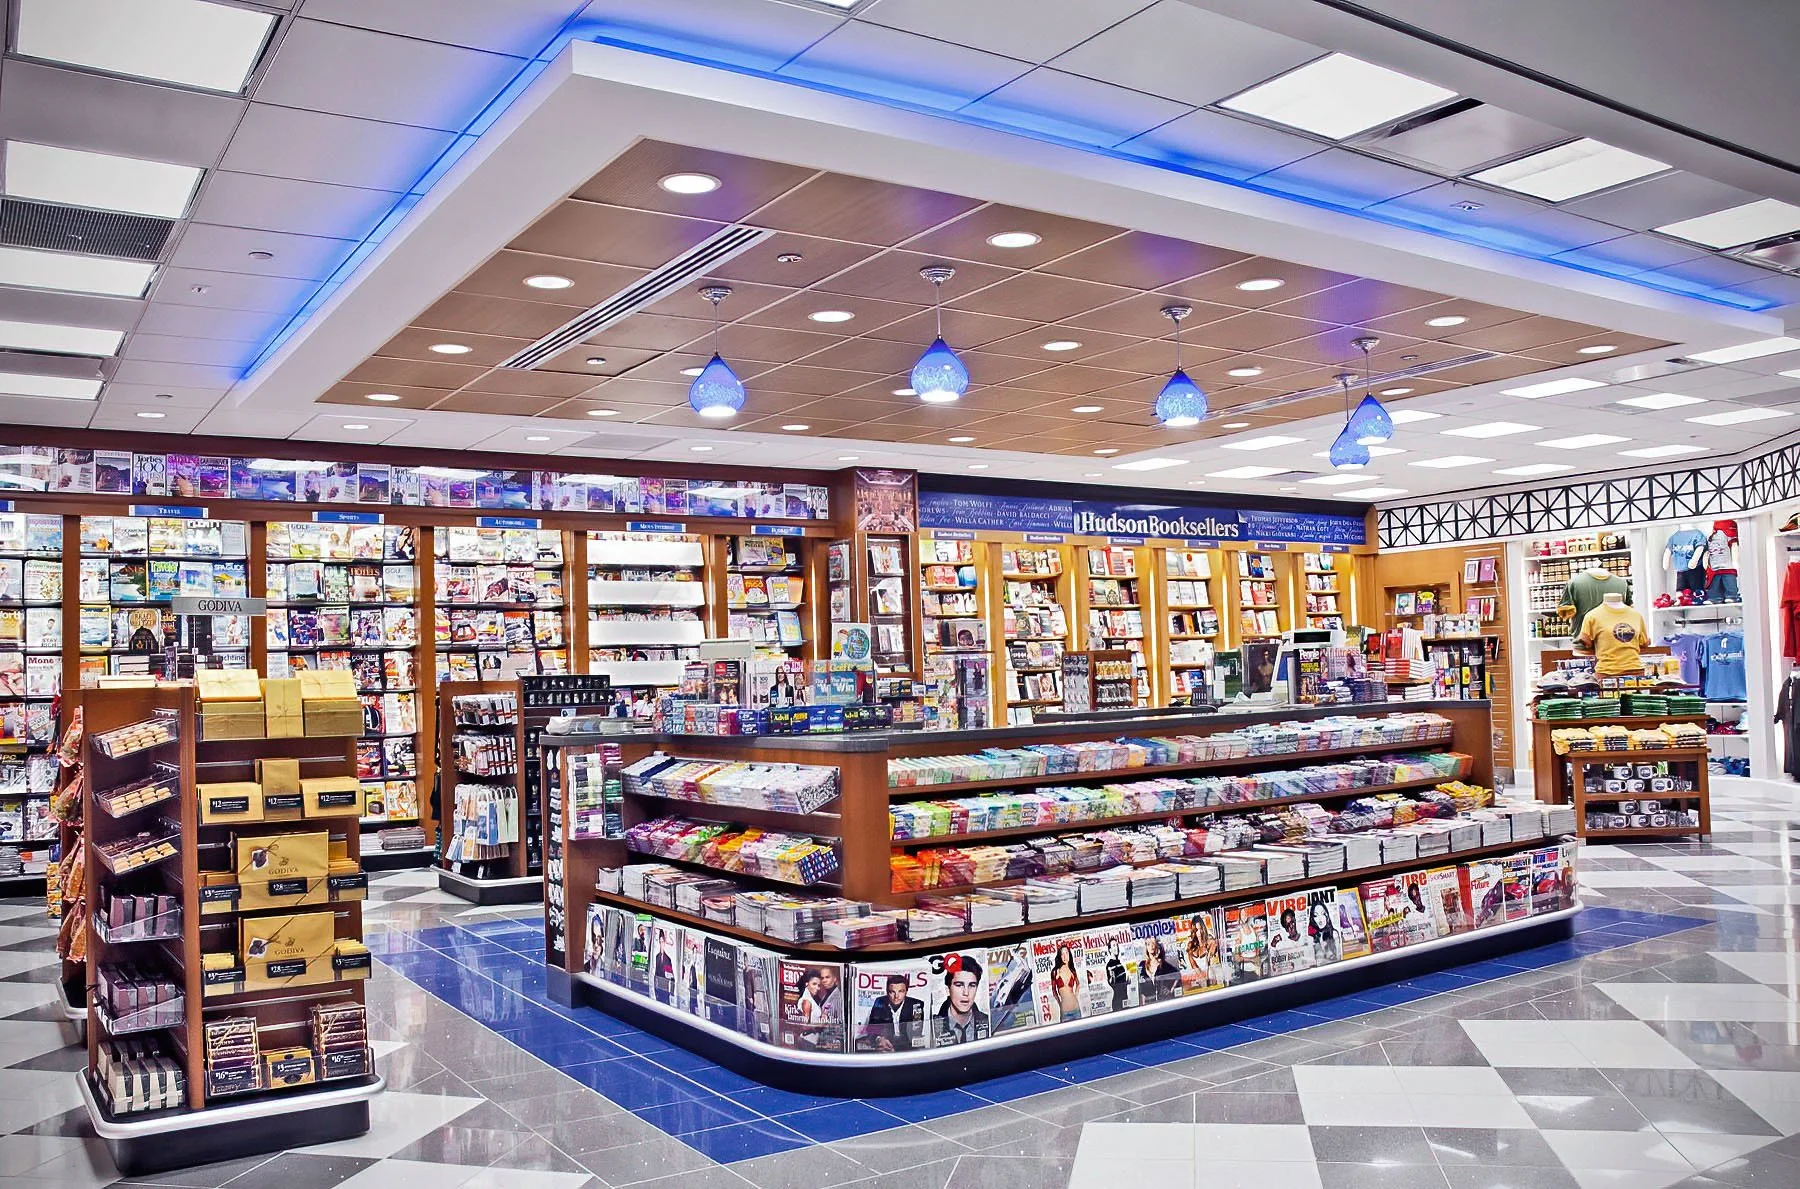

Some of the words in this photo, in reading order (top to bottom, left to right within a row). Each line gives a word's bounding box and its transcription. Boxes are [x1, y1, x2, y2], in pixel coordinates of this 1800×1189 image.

[138, 455, 162, 463] Forbes
[135, 462, 164, 472] 400
[952, 498, 968, 507] TOM
[198, 600, 243, 612] GODIVA
[1299, 649, 1319, 662] People
[268, 867, 299, 875] GODIVA
[1033, 942, 1056, 957] Men's
[1073, 949, 1084, 958] 101
[783, 969, 804, 984] EBO
[1040, 995, 1052, 1022] 325
